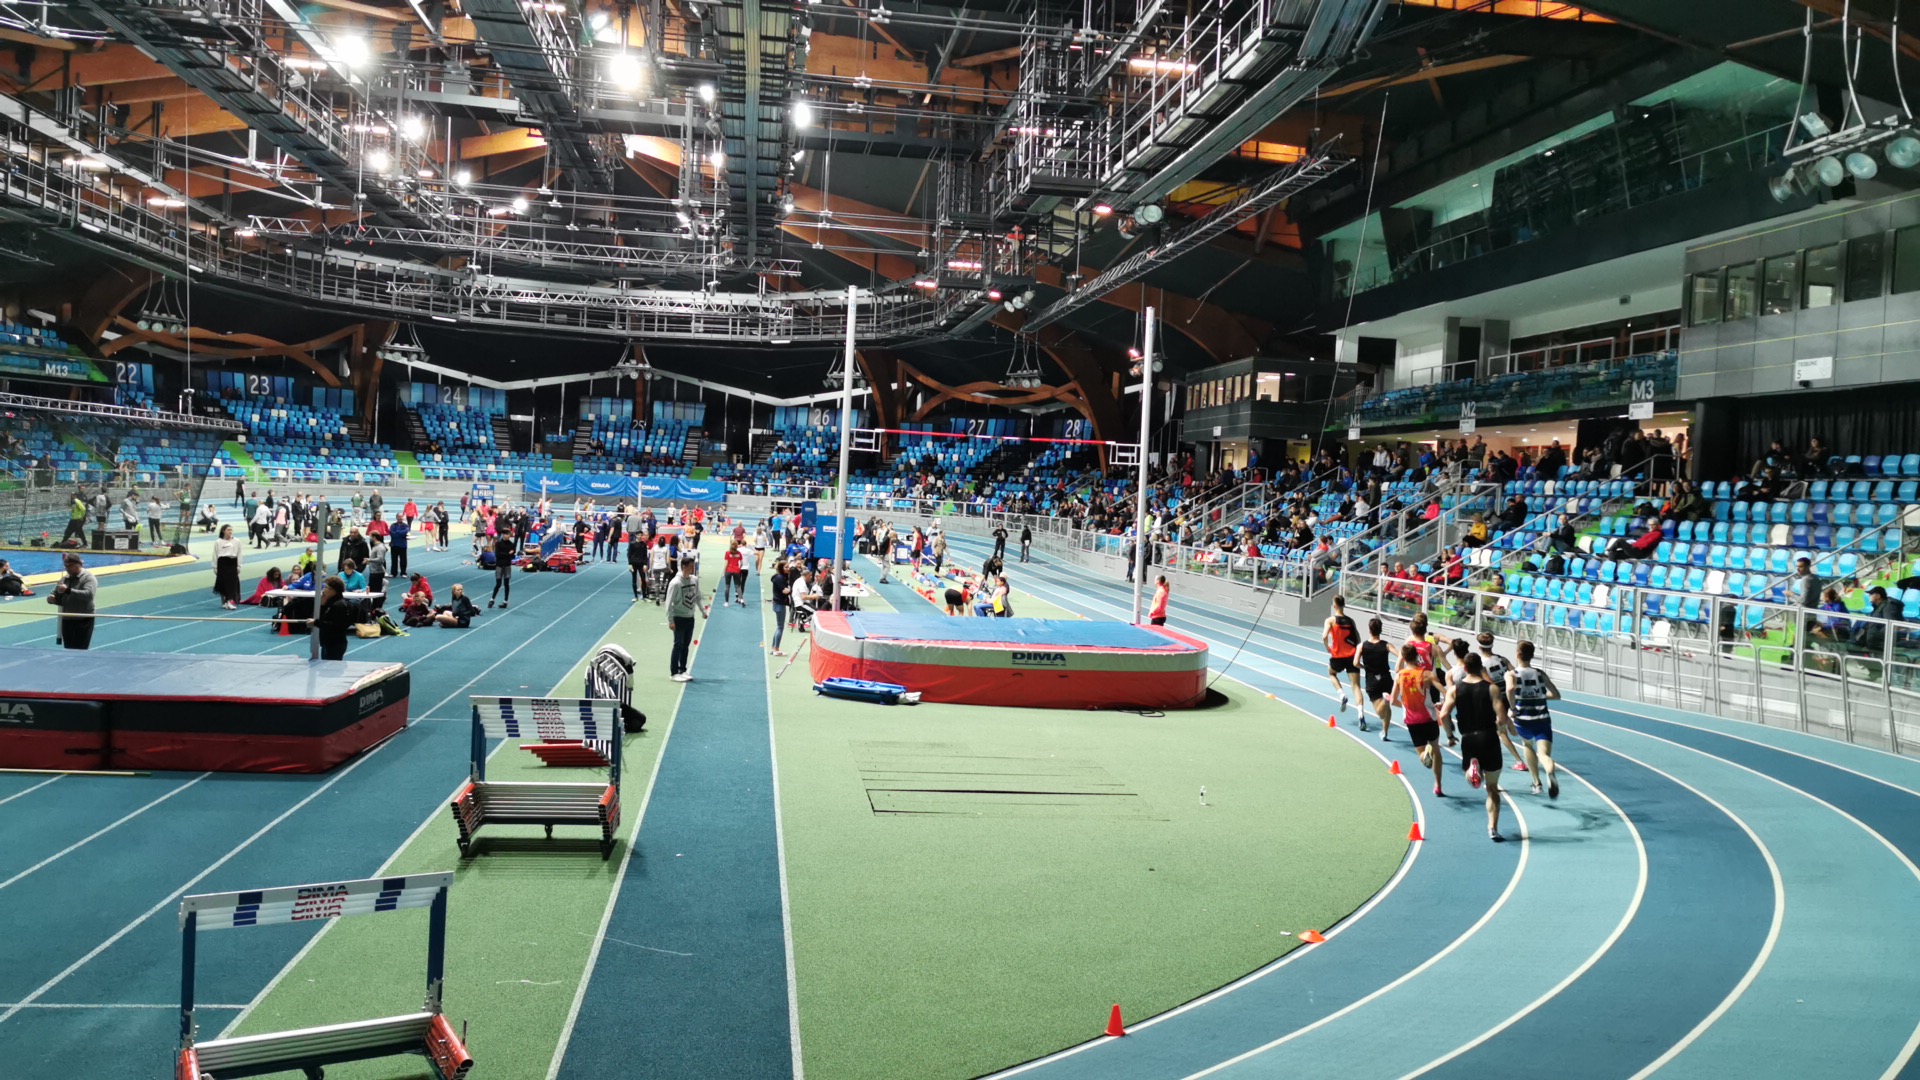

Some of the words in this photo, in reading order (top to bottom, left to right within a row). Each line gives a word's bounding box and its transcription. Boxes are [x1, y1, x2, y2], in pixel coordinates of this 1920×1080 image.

[45, 363, 69, 377] M13
[116, 362, 138, 384] 22
[1796, 369, 1802, 380] 5
[249, 374, 270, 395] 23
[1631, 380, 1655, 401] M3
[443, 386, 462, 404] 24
[813, 408, 830, 426] 26
[1461, 401, 1476, 418] M2
[632, 419, 645, 430] 25
[967, 419, 985, 436] 27
[1065, 419, 1081, 438] 28
[1350, 413, 1360, 427] M1
[1012, 652, 1067, 662] DIMA
[360, 689, 384, 708] DIMA
[298, 885, 349, 899] DIMA
